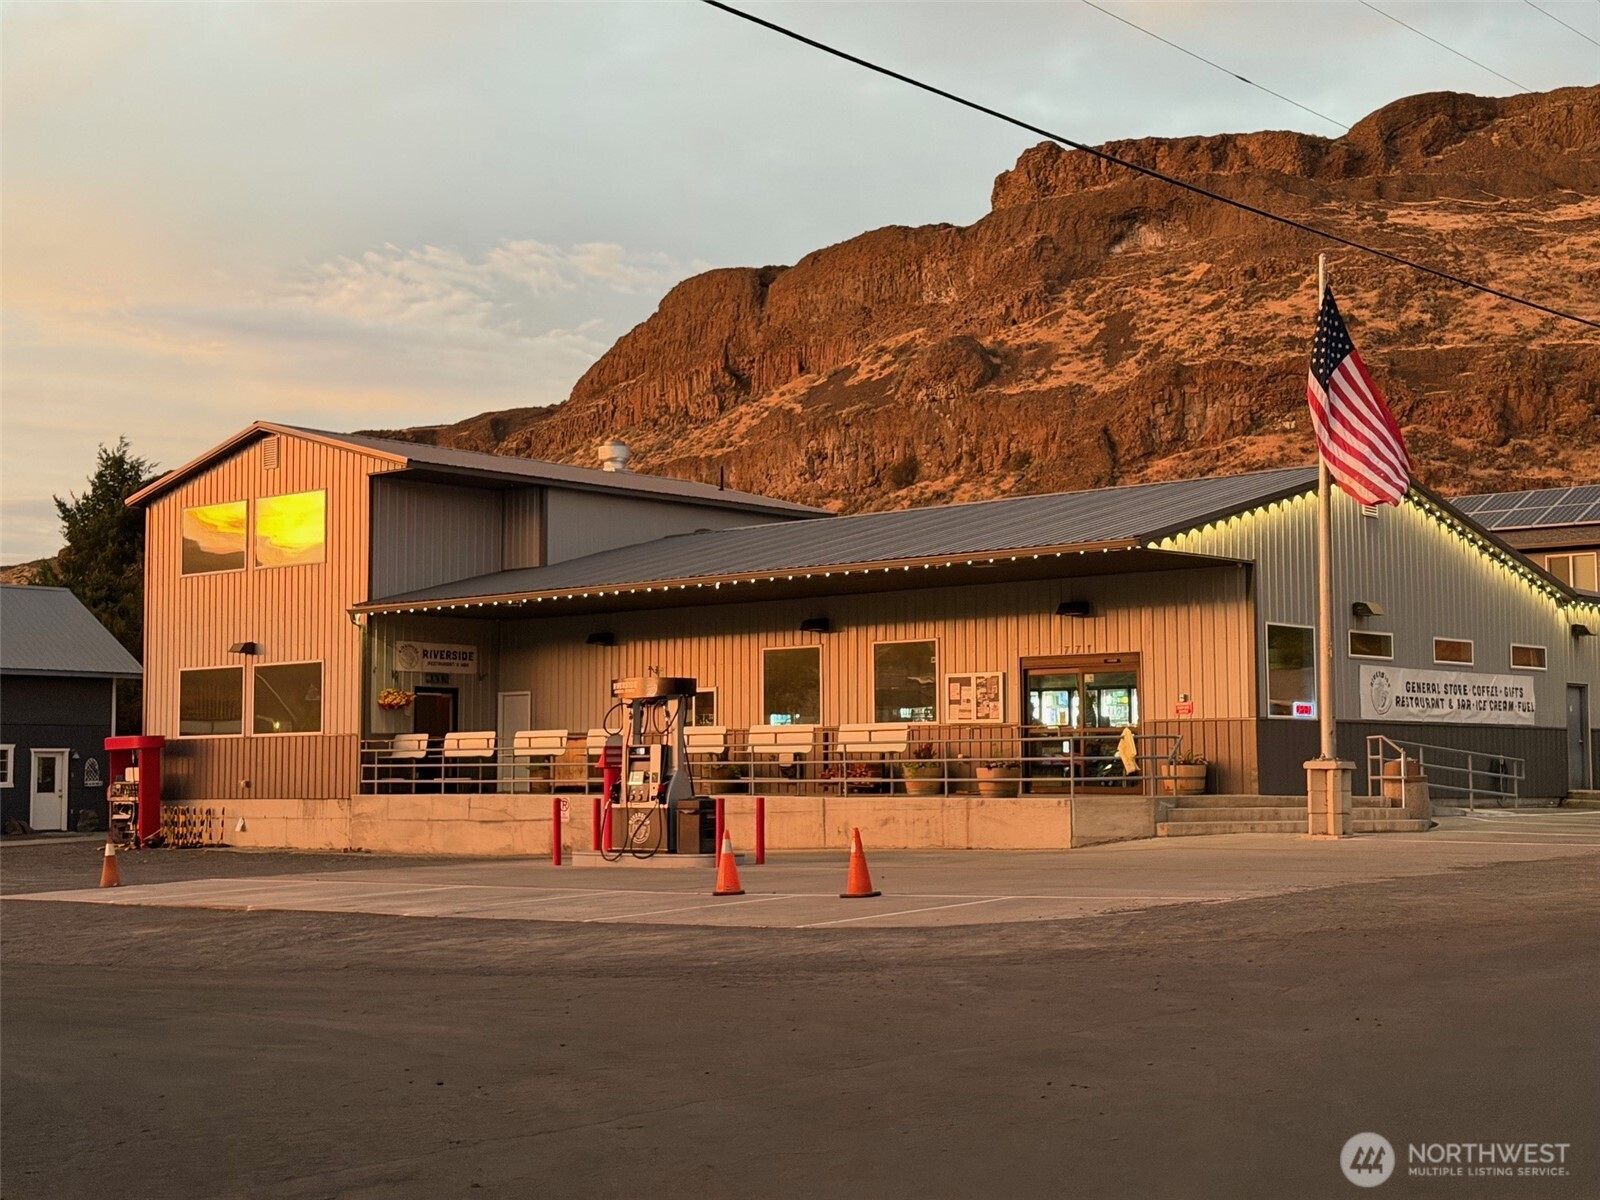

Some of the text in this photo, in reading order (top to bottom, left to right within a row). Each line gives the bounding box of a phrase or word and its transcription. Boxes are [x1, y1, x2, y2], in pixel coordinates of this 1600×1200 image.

[422, 649, 474, 661] RIVERSIDE
[1405, 681, 1524, 698] GENERAL STORE COFFEE GIFTS
[1395, 695, 1445, 709] RESTAURANT
[1475, 700, 1487, 711] ICE
[1489, 700, 1514, 712] CREAM
[1517, 701, 1535, 713] FUEL
